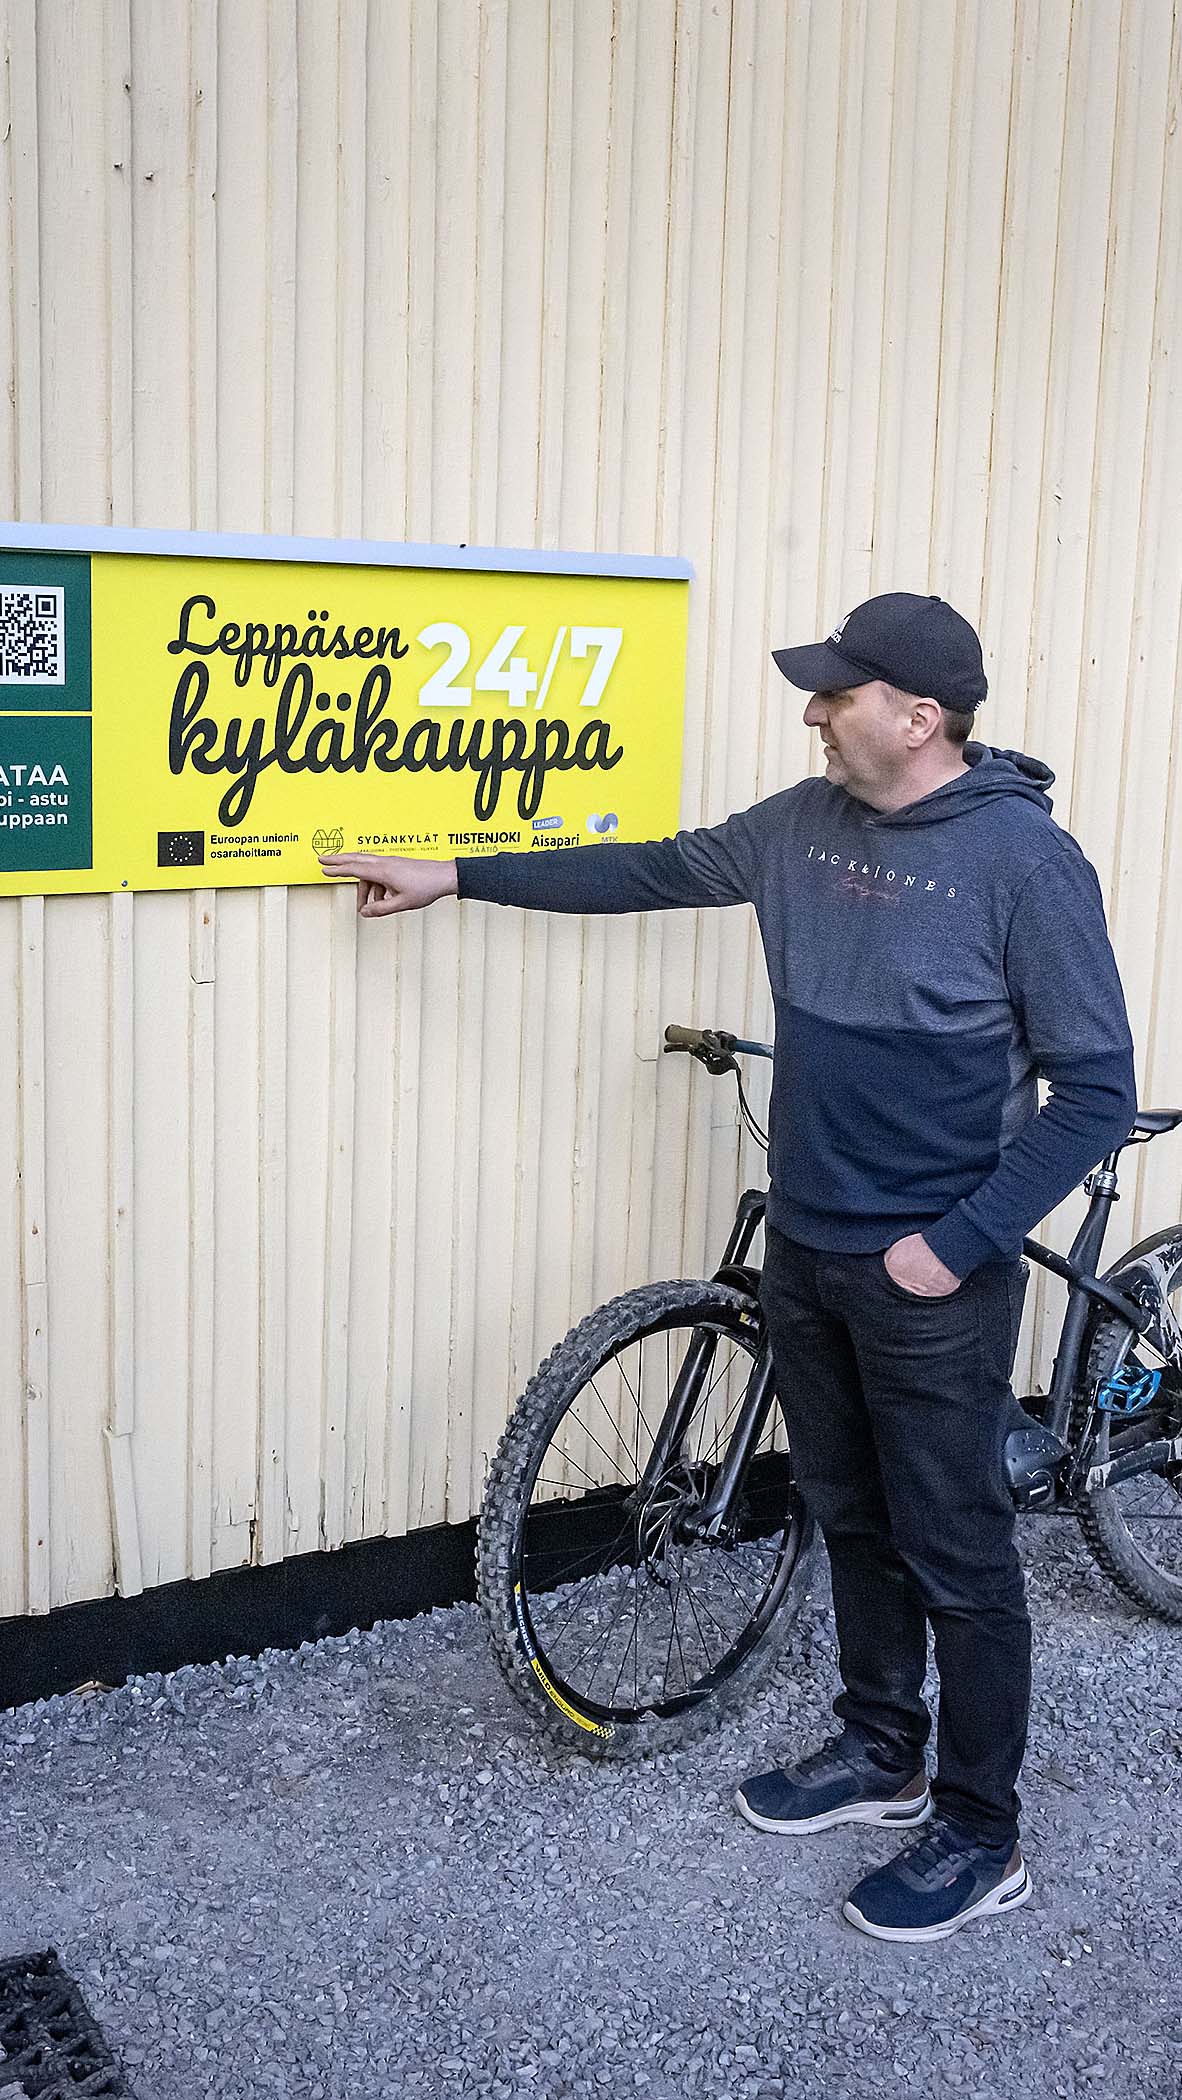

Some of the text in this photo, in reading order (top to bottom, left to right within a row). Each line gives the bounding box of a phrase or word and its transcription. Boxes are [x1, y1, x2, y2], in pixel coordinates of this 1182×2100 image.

[166, 594, 410, 688] Leppäsen
[416, 621, 624, 710] 24/7
[168, 660, 624, 828] kyläkauppa
[29, 792, 69, 806] astu
[0, 812, 68, 830] uppaan
[533, 817, 559, 829] LEADER
[210, 833, 299, 846] Euroopan unionin
[357, 833, 439, 845] SYDÄNKYLÄT
[447, 831, 521, 845] TIISTENJOKI
[531, 833, 580, 850] Aisapari
[210, 848, 282, 859] osarahoittama
